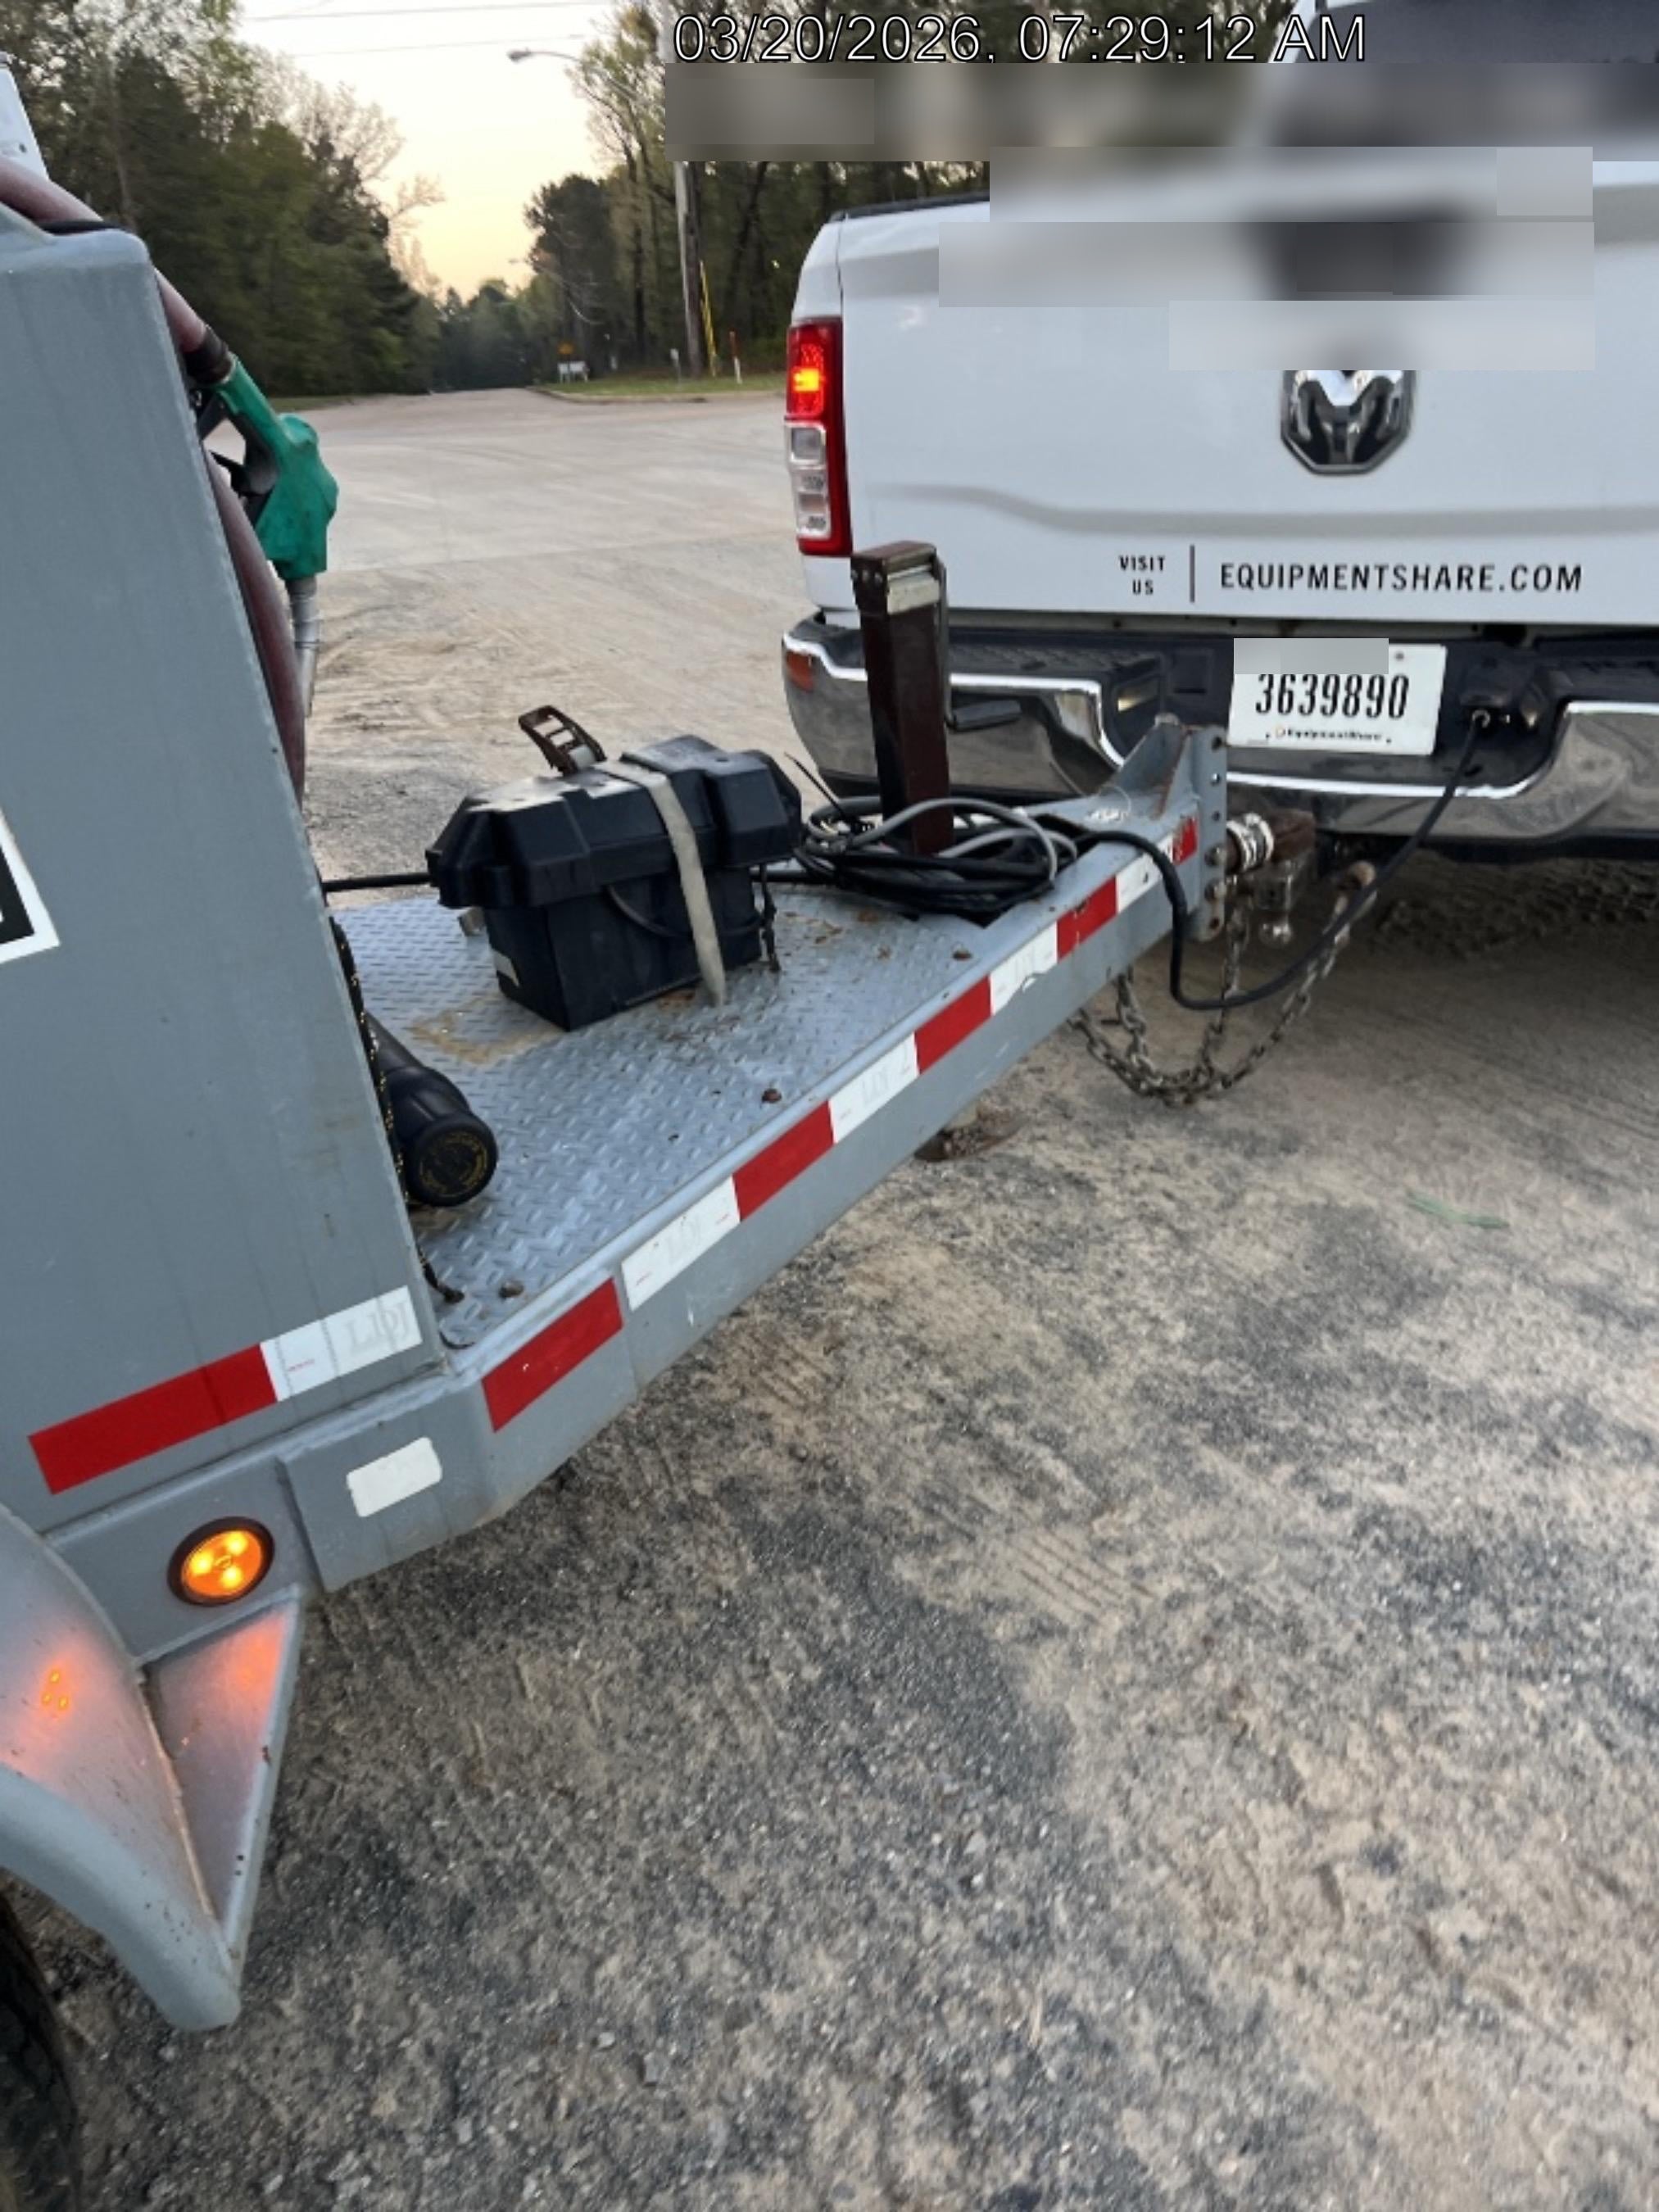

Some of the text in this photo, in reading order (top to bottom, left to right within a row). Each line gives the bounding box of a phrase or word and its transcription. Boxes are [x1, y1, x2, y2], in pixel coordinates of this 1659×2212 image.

[1118, 555, 1166, 572] VISIT
[1131, 579, 1154, 596] US
[1220, 563, 1583, 592] EQUIPMENTSHARE.COM
[1255, 673, 1410, 719] 3639890
